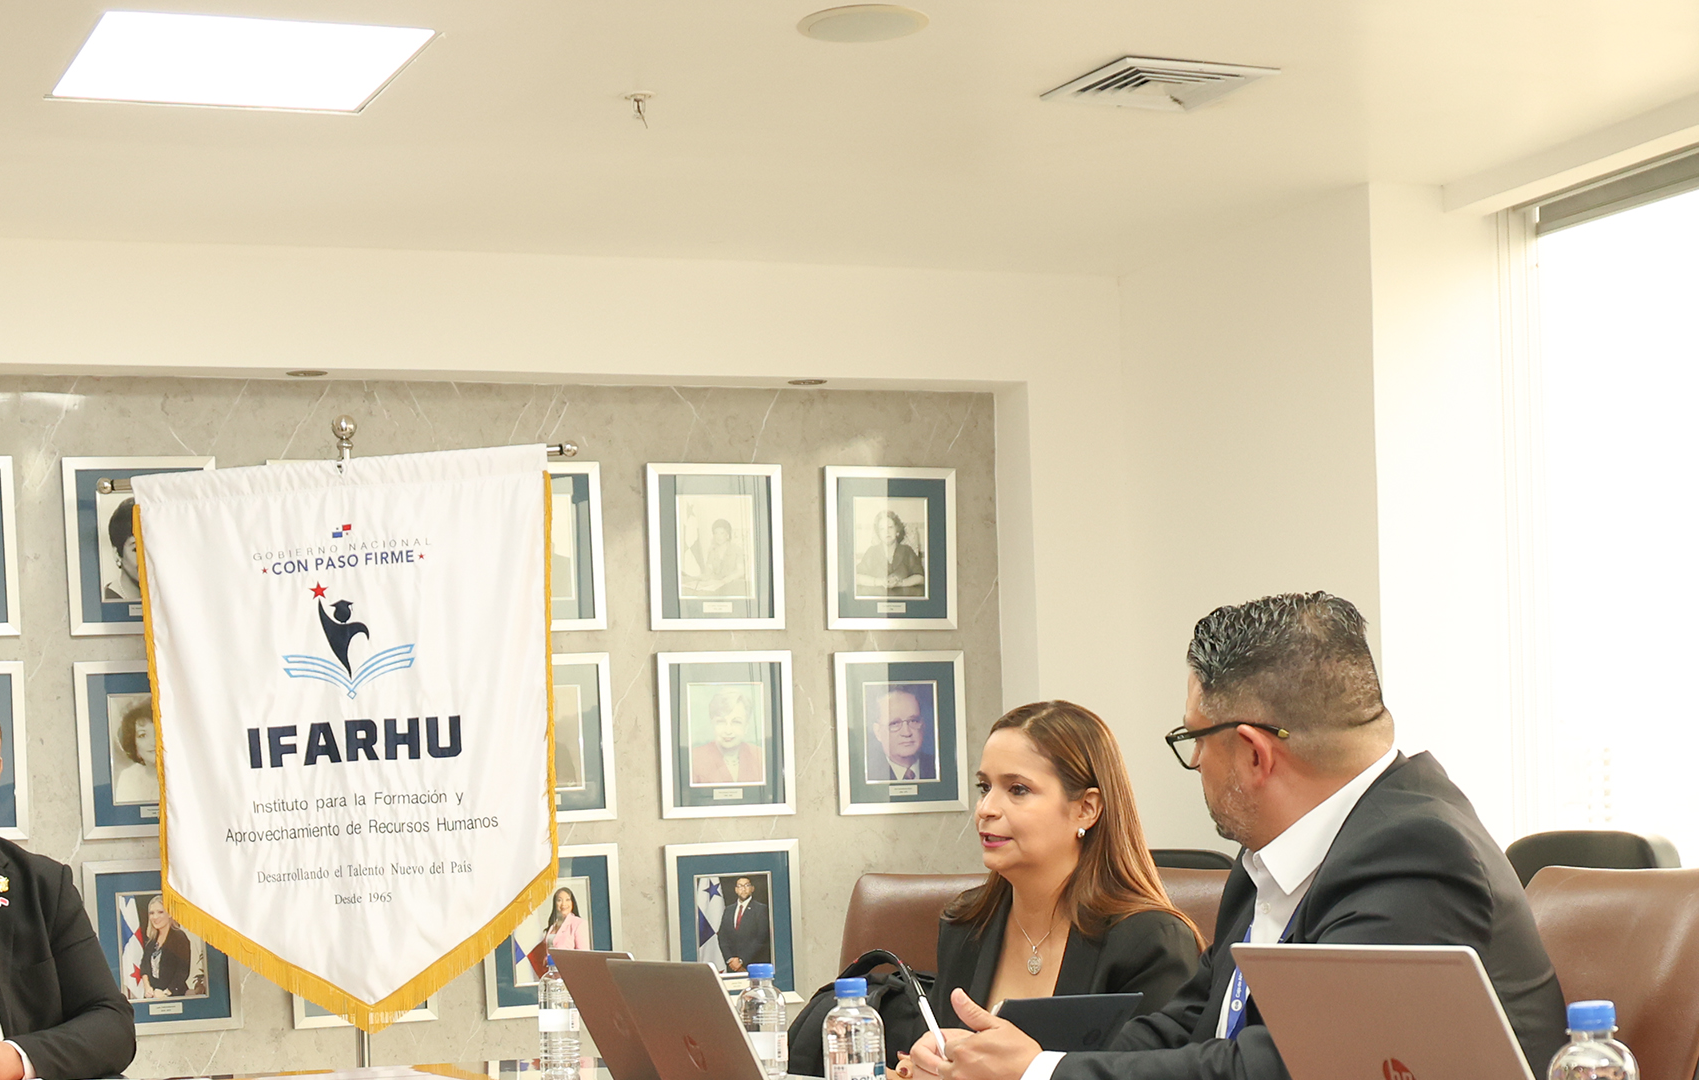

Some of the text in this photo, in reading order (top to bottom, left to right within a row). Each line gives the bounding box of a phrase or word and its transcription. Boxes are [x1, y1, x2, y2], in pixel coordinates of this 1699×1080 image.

[252, 538, 432, 561] GOBIERNO NACIONAL
[271, 549, 415, 575] CON PASO FIRME
[247, 715, 462, 769] IFARHU
[252, 790, 464, 815] Instituto para la Formación y
[225, 814, 499, 846] Aprovechamiento de Recursos Humanos
[257, 867, 330, 884] Desarrollando
[334, 864, 343, 878] el
[347, 864, 385, 878] Talento
[391, 862, 425, 876] Nuevo
[429, 861, 445, 875] del
[334, 891, 393, 905] Desde 1965
